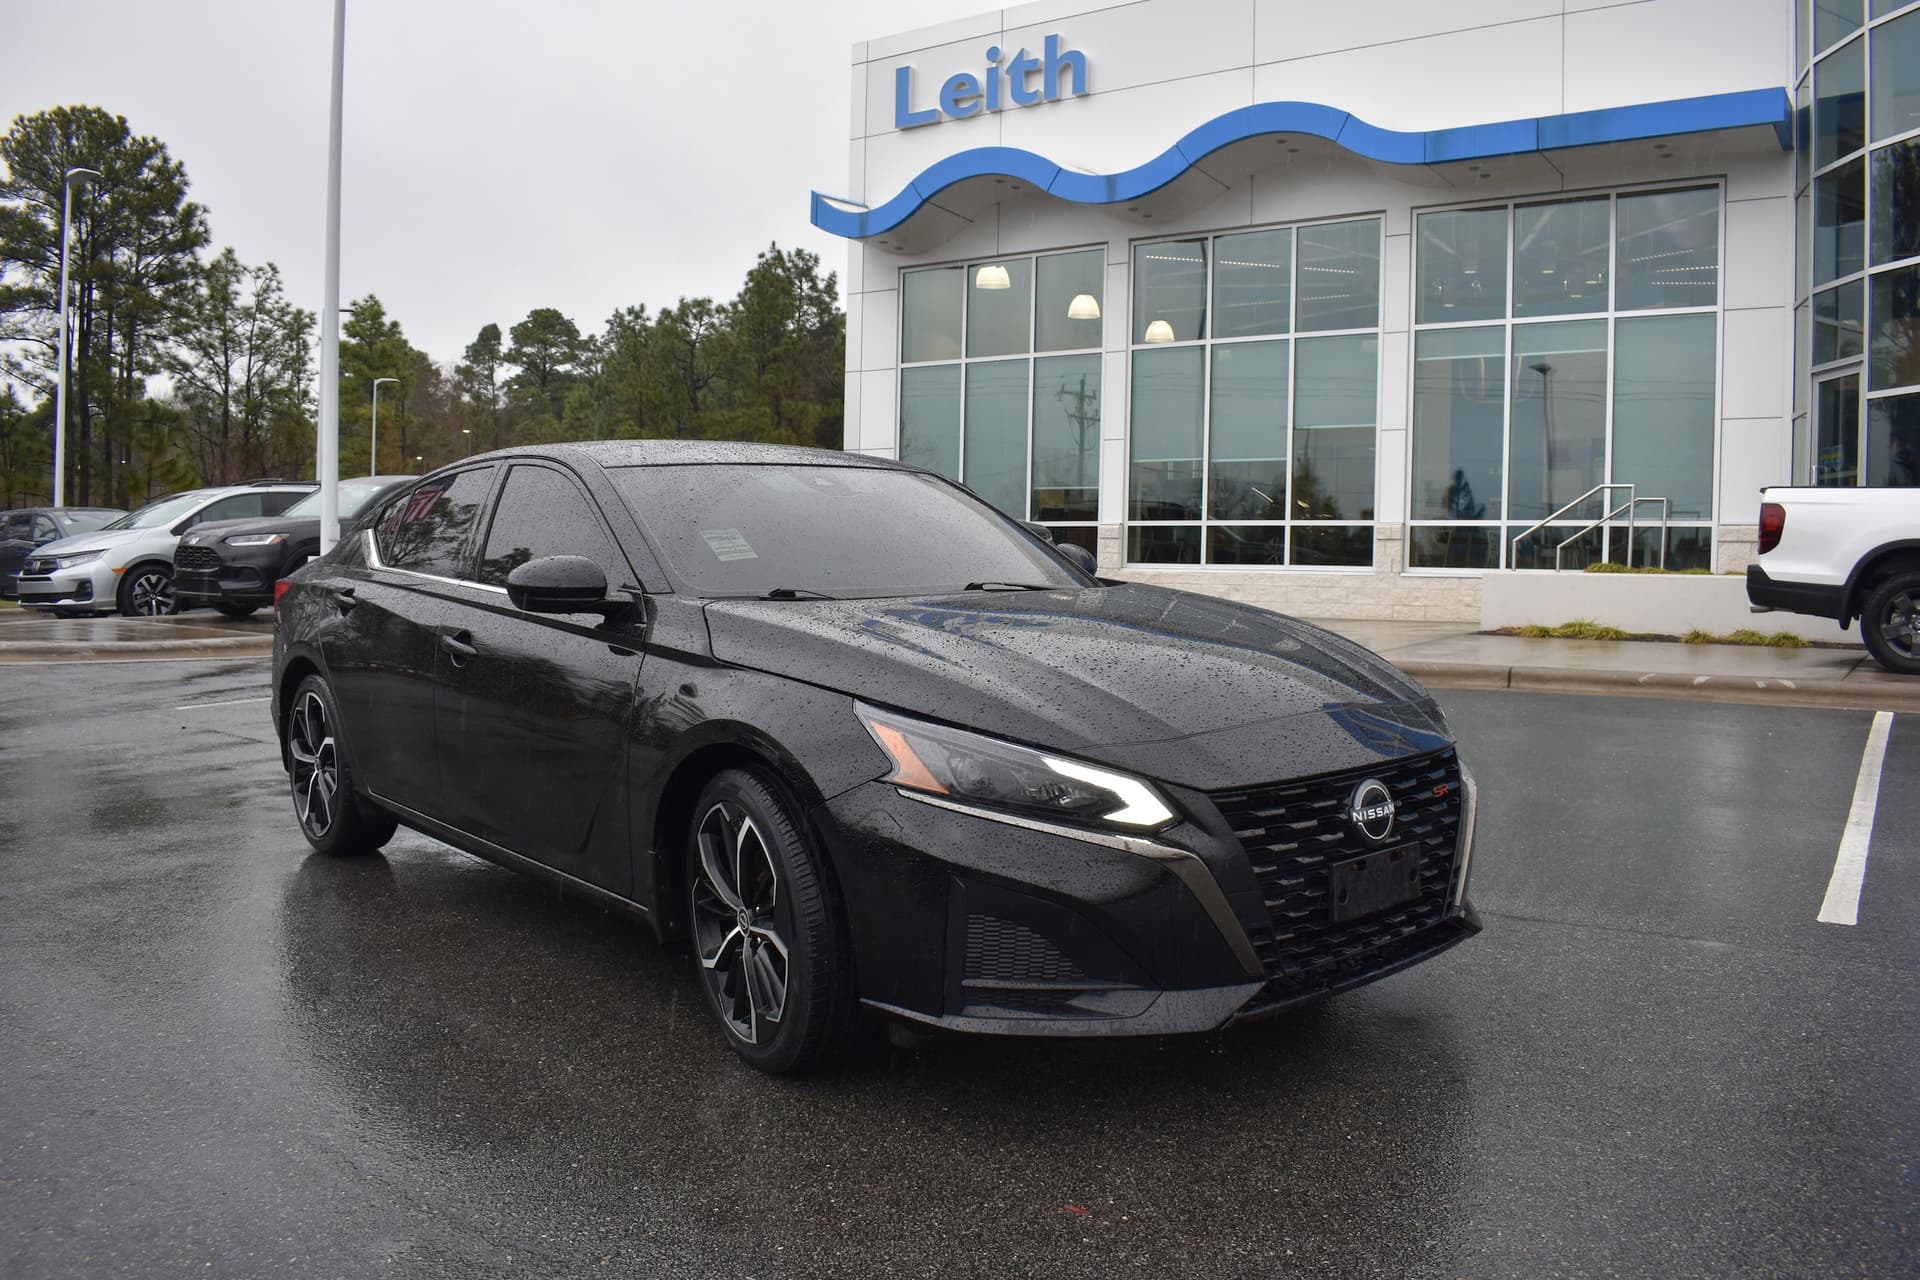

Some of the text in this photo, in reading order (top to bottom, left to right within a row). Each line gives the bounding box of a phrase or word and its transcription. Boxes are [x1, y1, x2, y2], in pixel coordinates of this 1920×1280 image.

[895, 33, 1087, 129] Leith
[1432, 784, 1449, 798] SR
[1352, 803, 1394, 822] NISSAN
